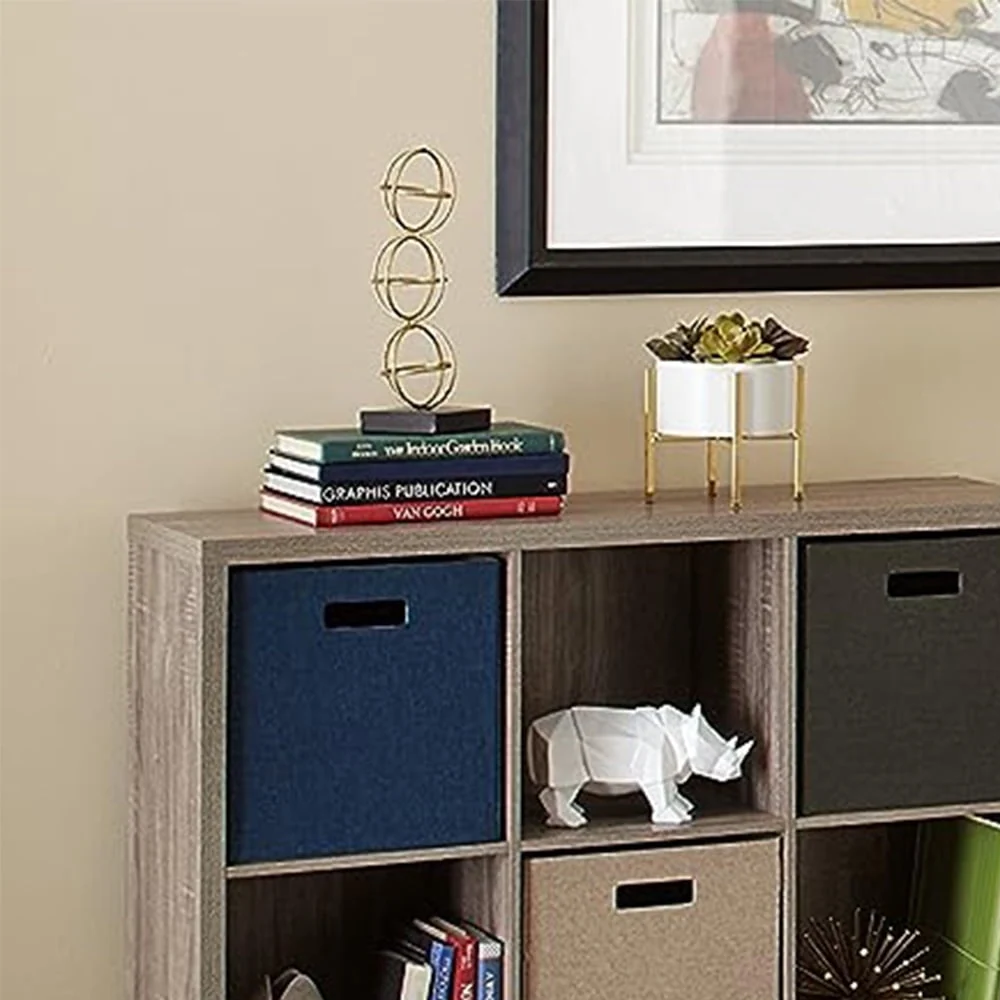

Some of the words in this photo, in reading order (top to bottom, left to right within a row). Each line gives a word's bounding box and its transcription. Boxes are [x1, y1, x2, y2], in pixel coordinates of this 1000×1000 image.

[321, 484, 391, 502] GRAPHIS
[395, 481, 494, 499] PUBLICATION
[392, 505, 422, 519] VAN
[423, 502, 464, 518] GOGH
